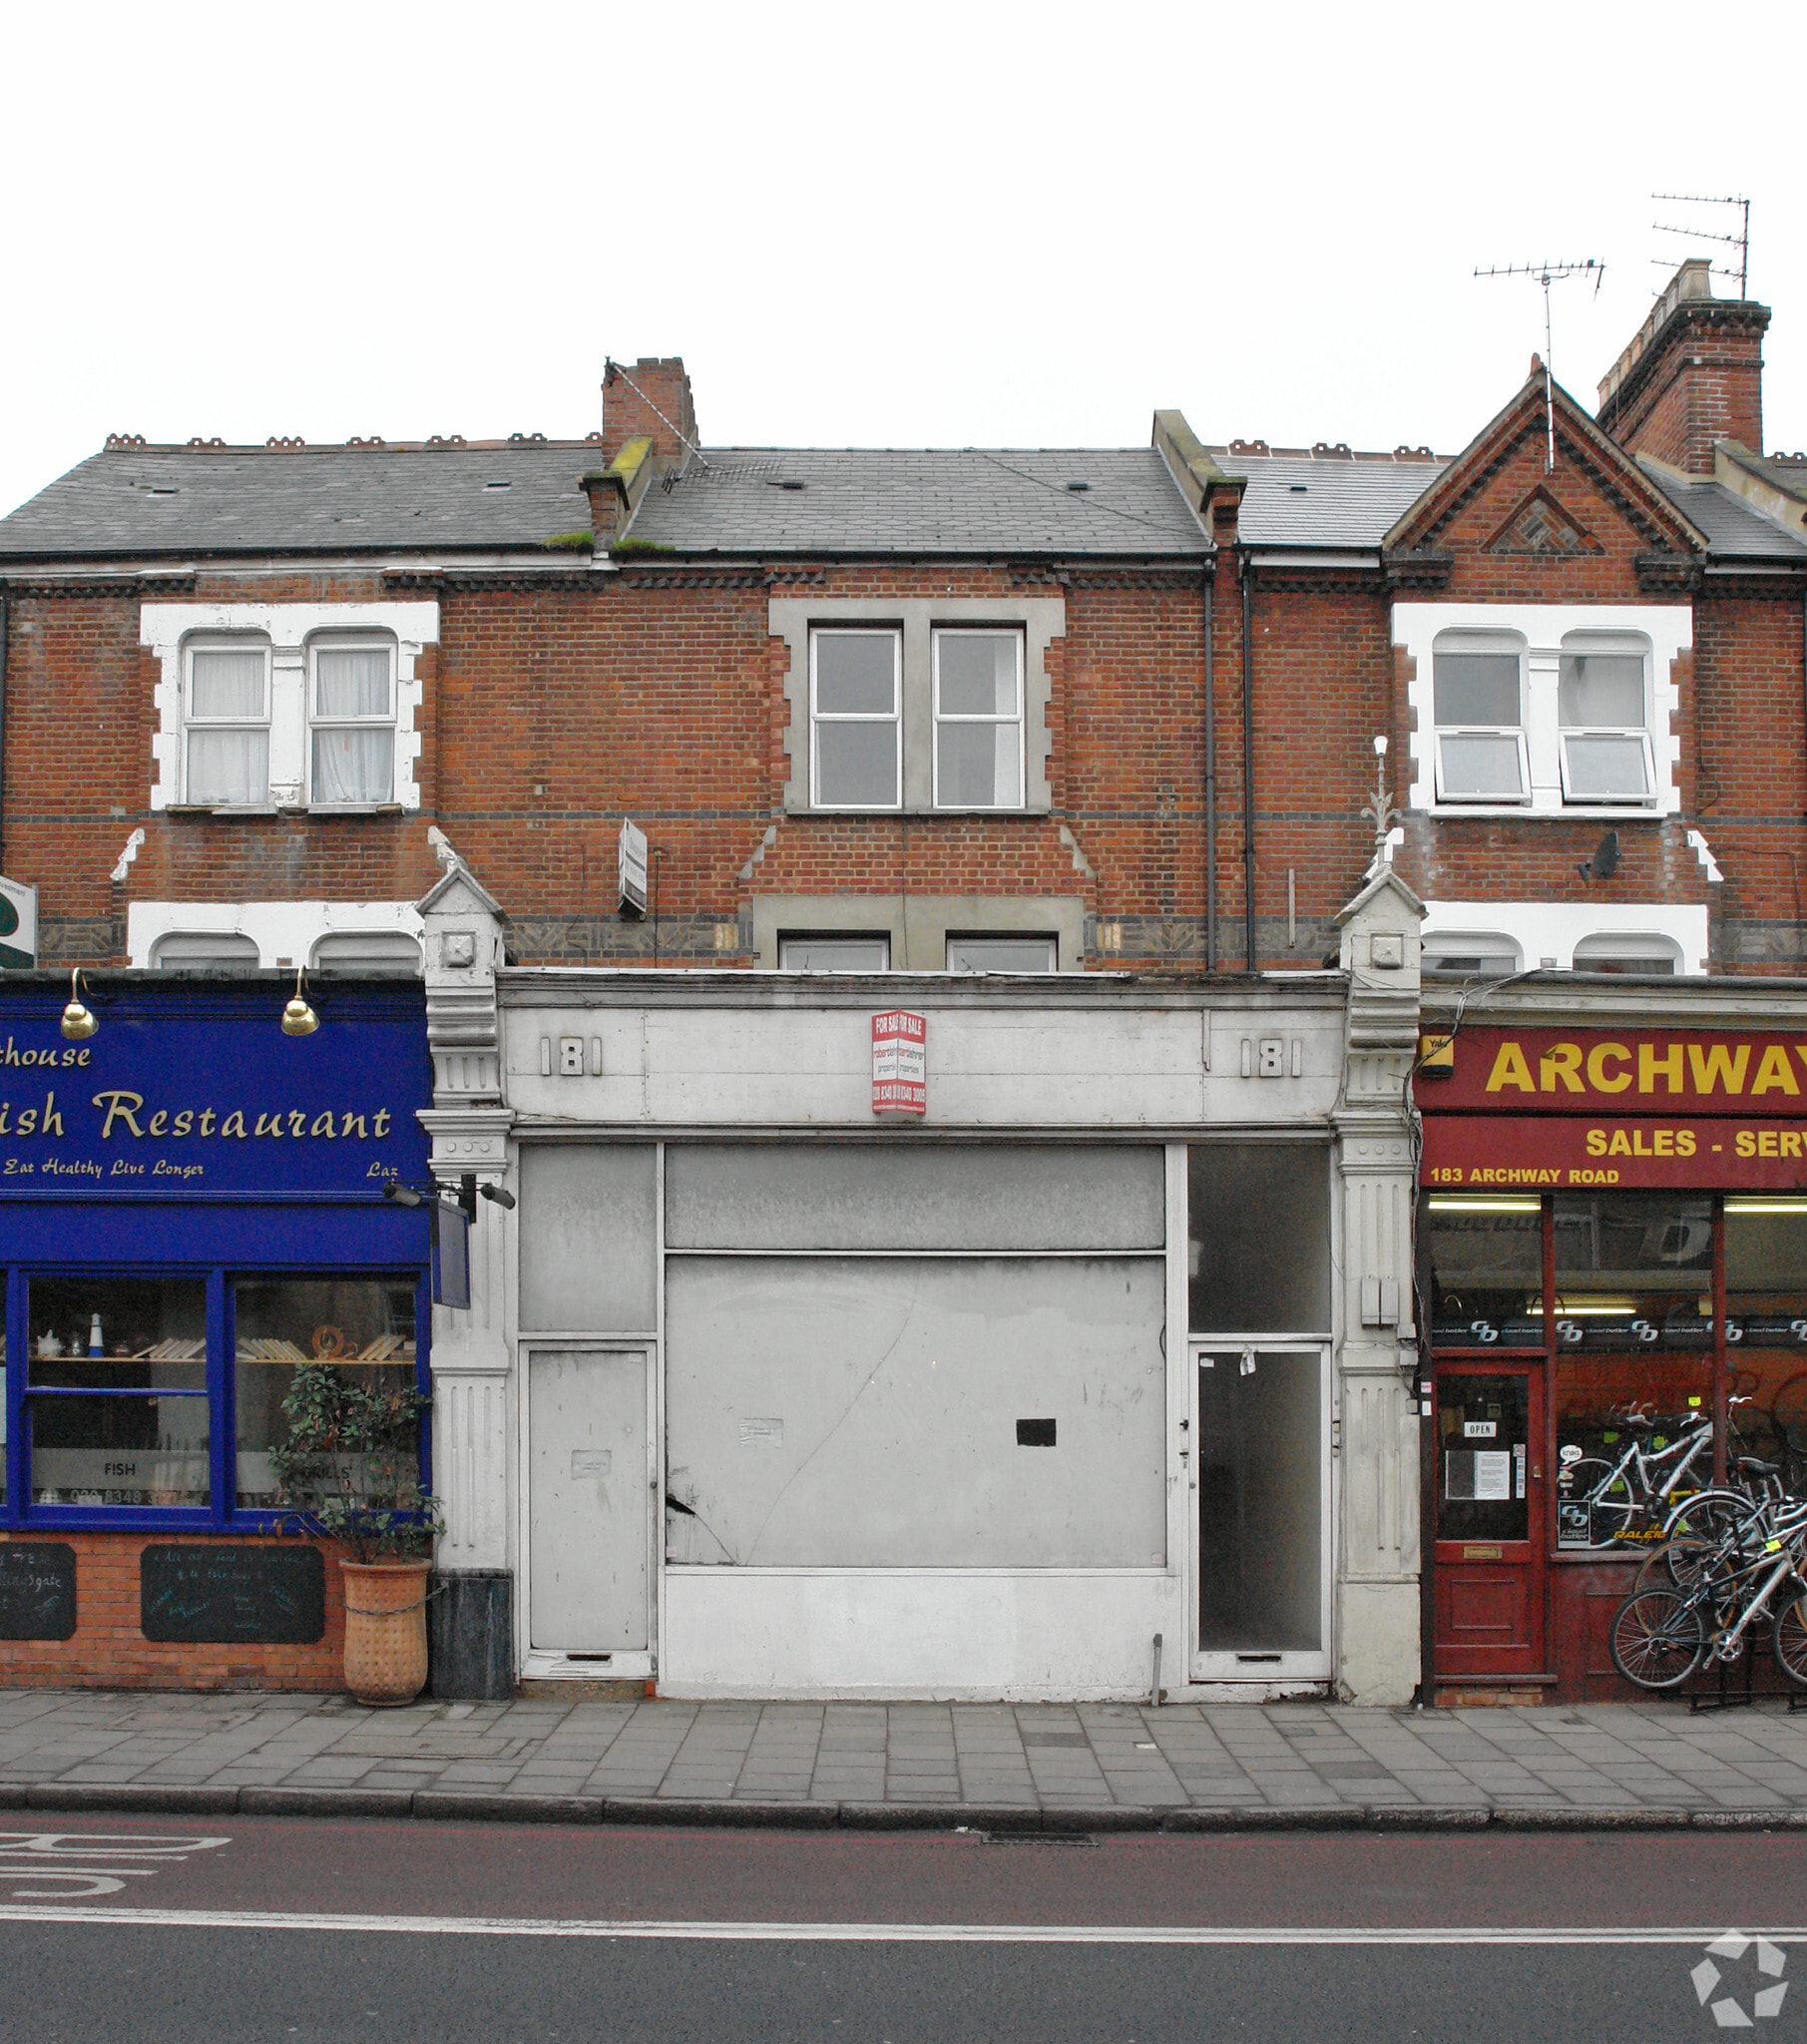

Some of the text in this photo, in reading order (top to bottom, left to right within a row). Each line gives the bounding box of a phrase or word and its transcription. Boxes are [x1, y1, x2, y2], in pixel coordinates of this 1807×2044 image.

[876, 1017, 888, 1034] FOR
[908, 1017, 922, 1036] SALE
[541, 1037, 602, 1076] 181
[1241, 1039, 1301, 1078] 181
[1485, 1042, 1807, 1095] ARCHWA
[92, 1090, 391, 1139] Restaurant
[1586, 1129, 1697, 1157] SALES
[1734, 1130, 1807, 1158] SER
[3, 1159, 204, 1179] Eat Healthy Live Longer
[1431, 1168, 1619, 1184] 183 ARCHWAY ROAD
[1469, 1424, 1491, 1434] OPEN
[104, 1462, 136, 1476] FISH
